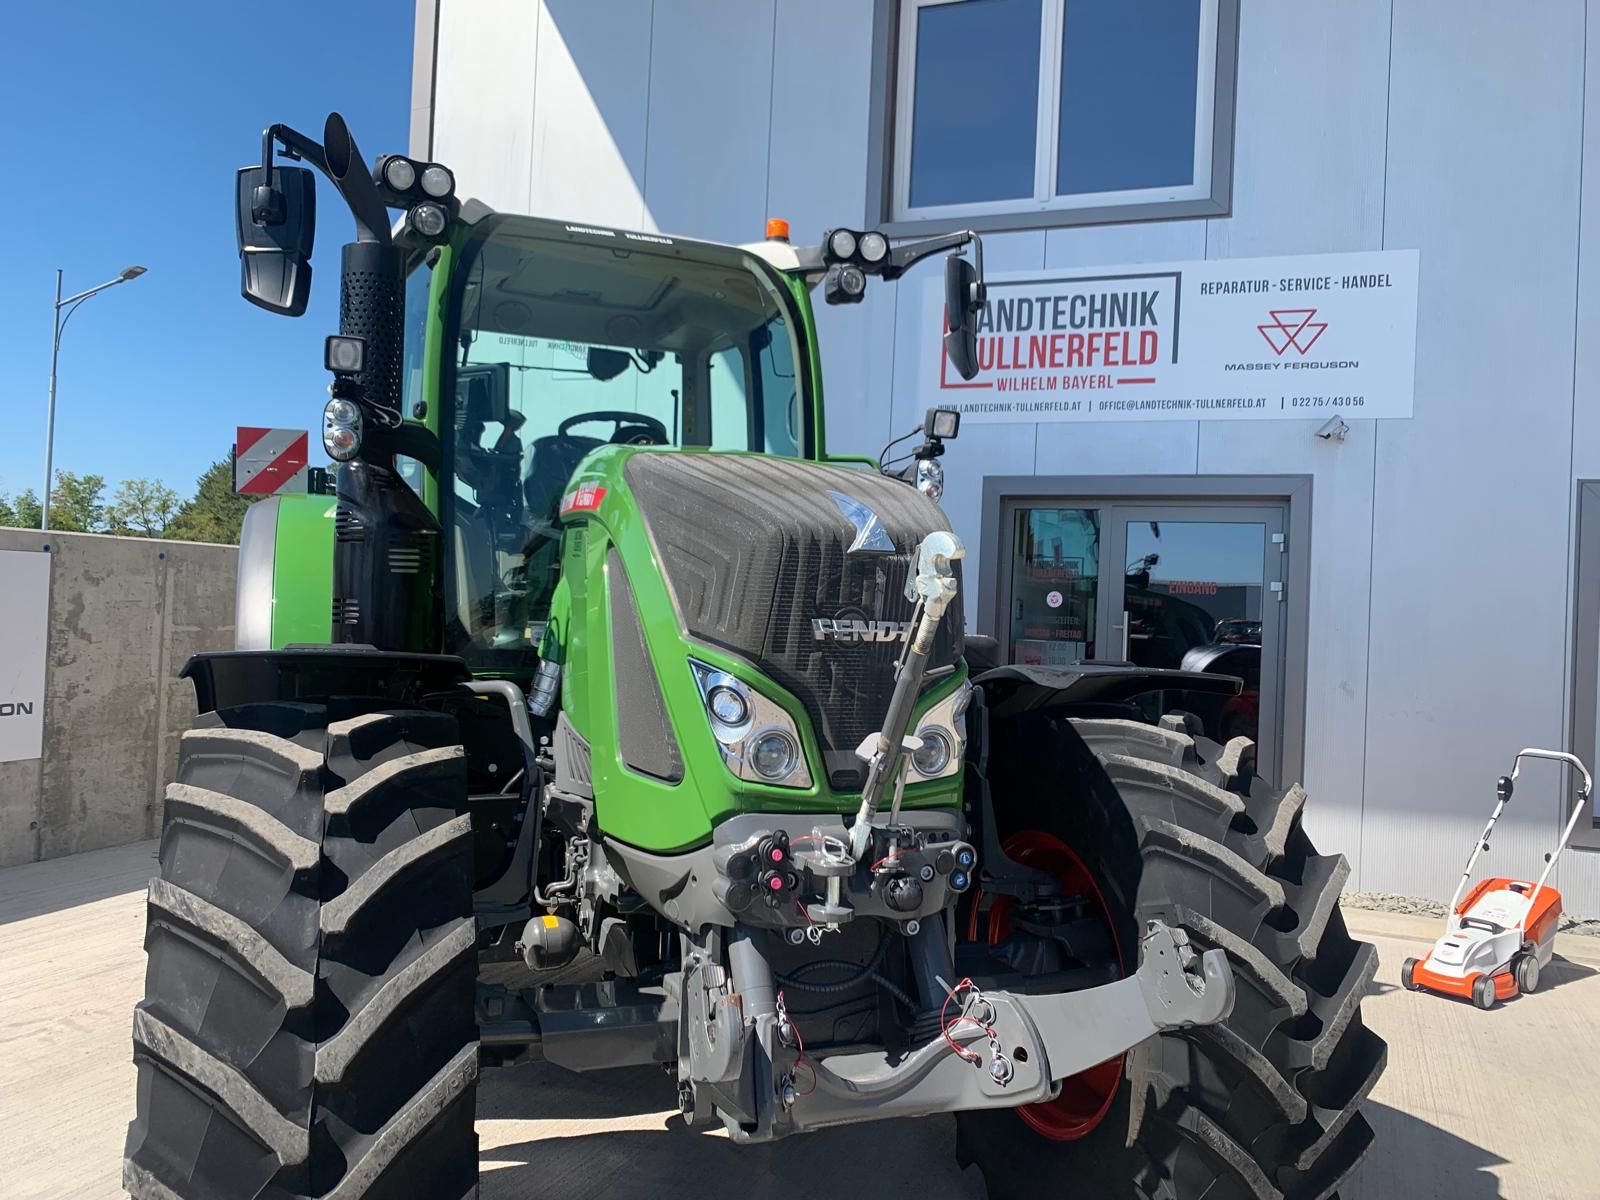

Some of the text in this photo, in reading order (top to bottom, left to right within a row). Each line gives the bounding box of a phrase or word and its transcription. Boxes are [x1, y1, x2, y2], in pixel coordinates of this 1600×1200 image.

[1200, 280, 1269, 296] REPARATUR
[1279, 277, 1331, 292] SERVICE
[1342, 274, 1392, 289] HANDEL
[976, 291, 1160, 334] ANDTECHNIK
[977, 330, 1158, 371] ULLNERFELD
[1224, 361, 1359, 371] MASSEY FERGUSON
[997, 375, 1114, 392] WILHELM BAYERL
[1099, 398, 1267, 411] OFFICE@LANDTECHNIK-TULLNERFELD.AT
[811, 618, 919, 642] FENDT
